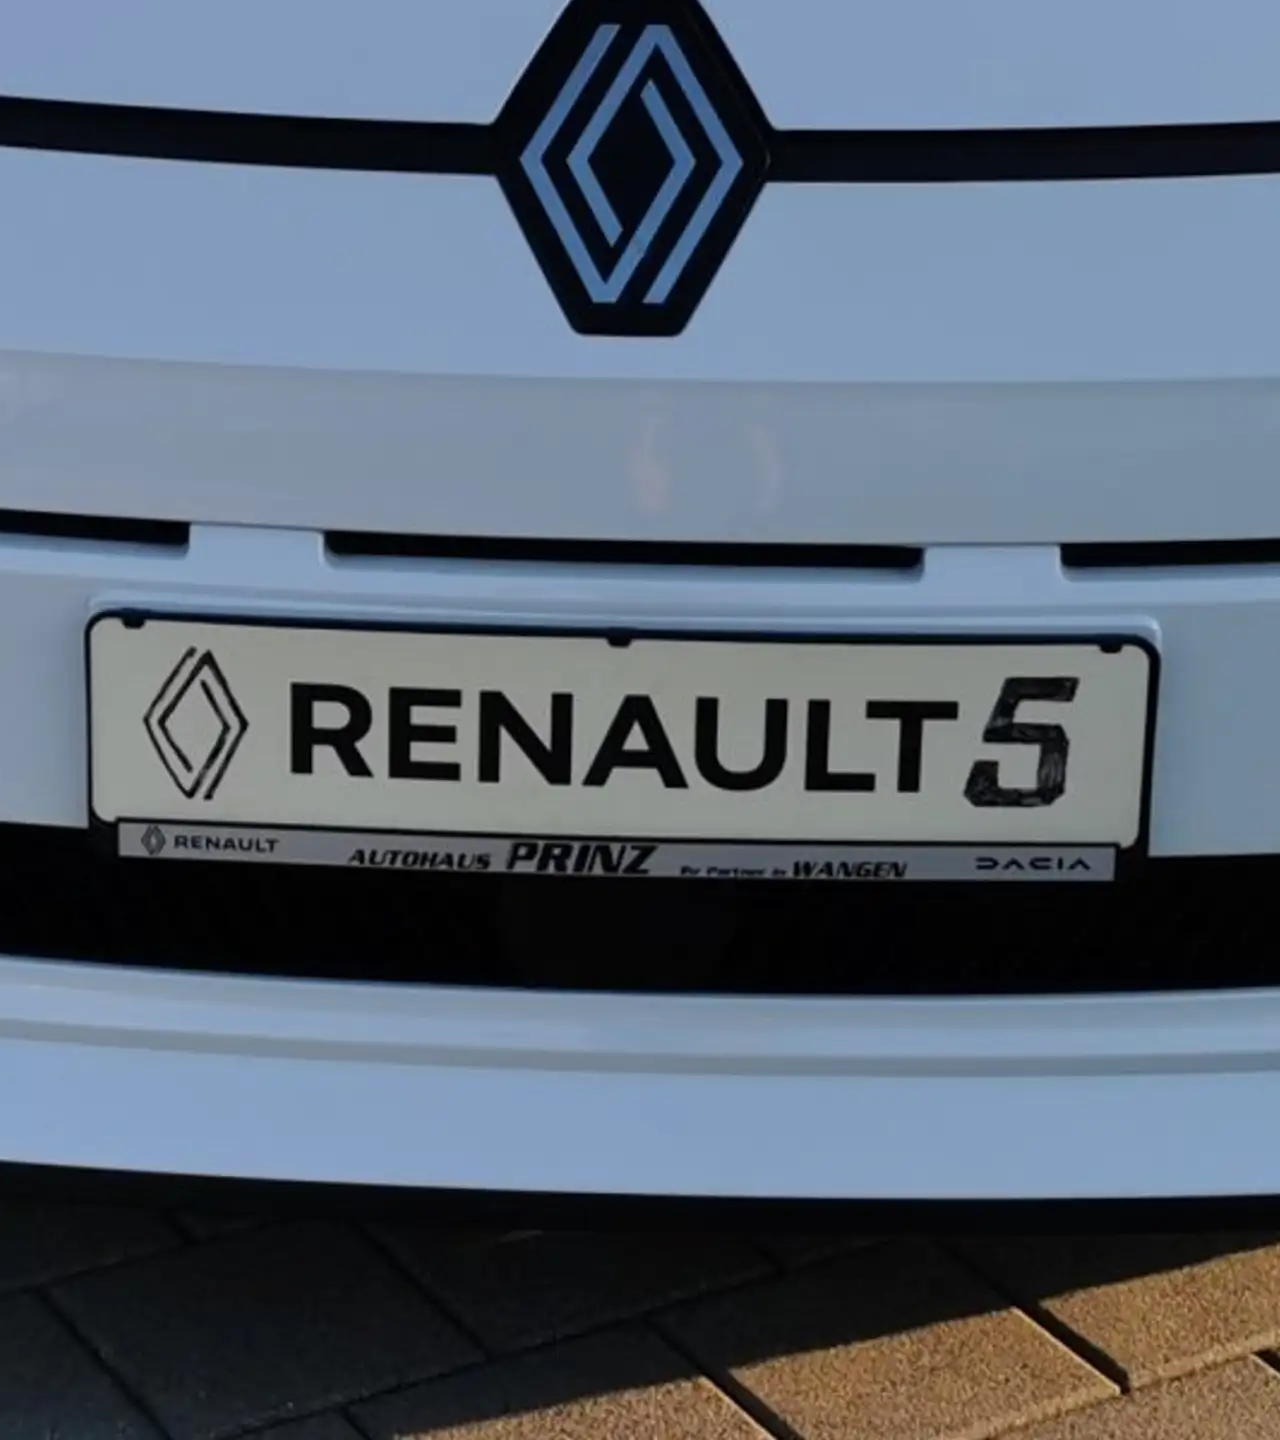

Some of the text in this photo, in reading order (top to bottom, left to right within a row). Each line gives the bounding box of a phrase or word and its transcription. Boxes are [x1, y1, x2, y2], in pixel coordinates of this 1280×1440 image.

[289, 676, 1080, 808] RENAULT 5
[173, 833, 281, 854] RENAULT
[349, 848, 492, 870] AUTOHAUS
[506, 840, 658, 875] PRINZ
[792, 860, 909, 878] WANGEN
[974, 856, 1092, 872] DACIA
